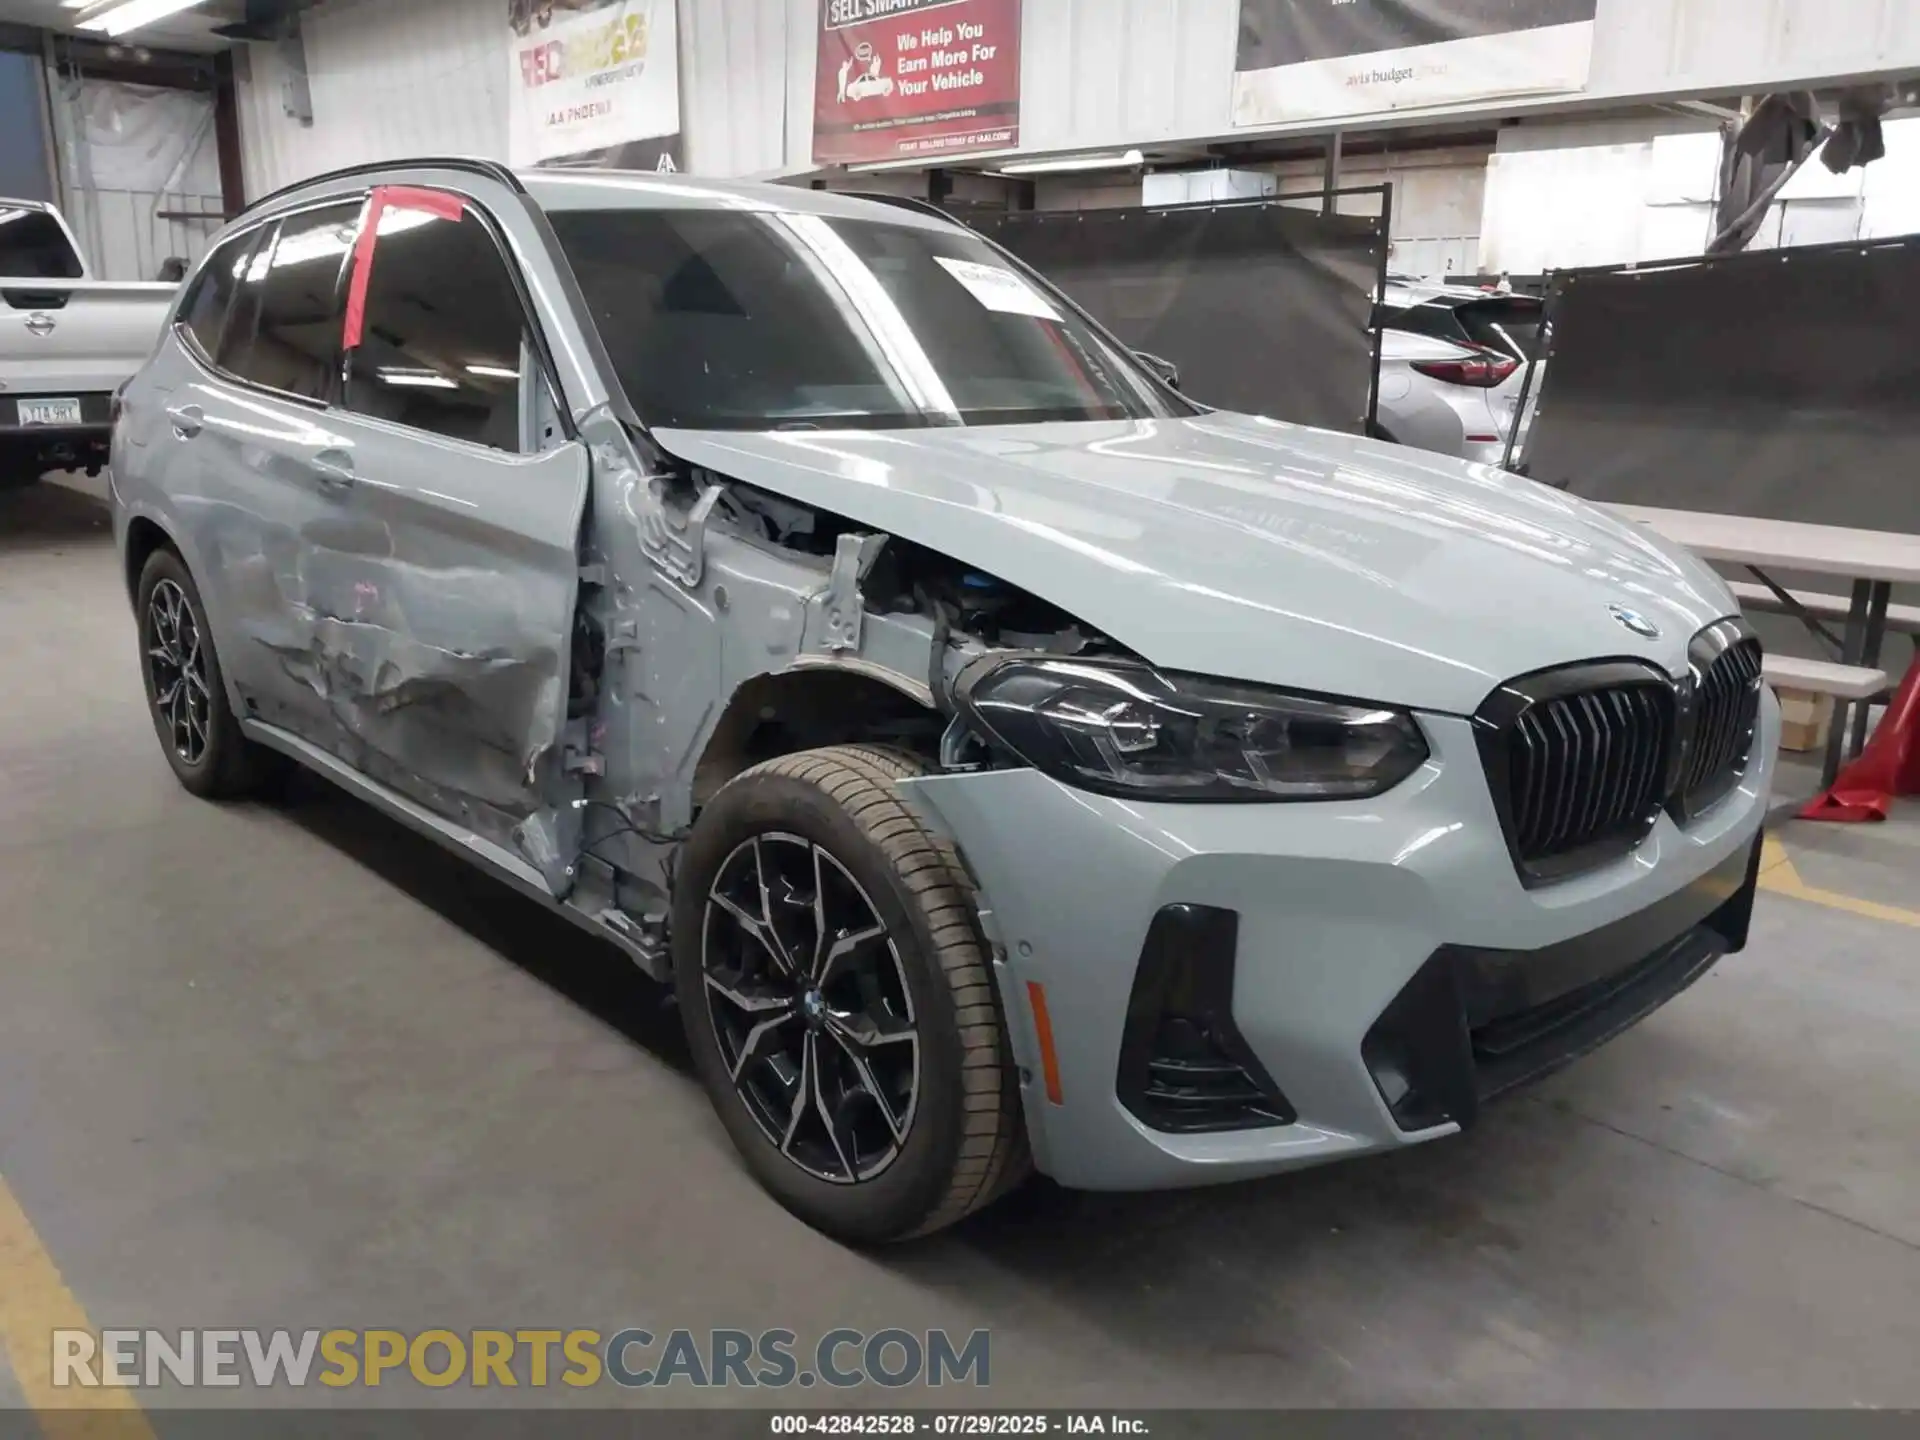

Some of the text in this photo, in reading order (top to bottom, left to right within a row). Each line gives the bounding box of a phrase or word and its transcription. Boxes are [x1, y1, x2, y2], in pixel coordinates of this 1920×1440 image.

[830, 0, 862, 22] SELL
[897, 22, 984, 52] We Help You
[897, 43, 997, 75] Earn More For
[898, 68, 984, 97] Your Vehicle
[1346, 71, 1371, 86] avis
[1372, 67, 1413, 84] budget
